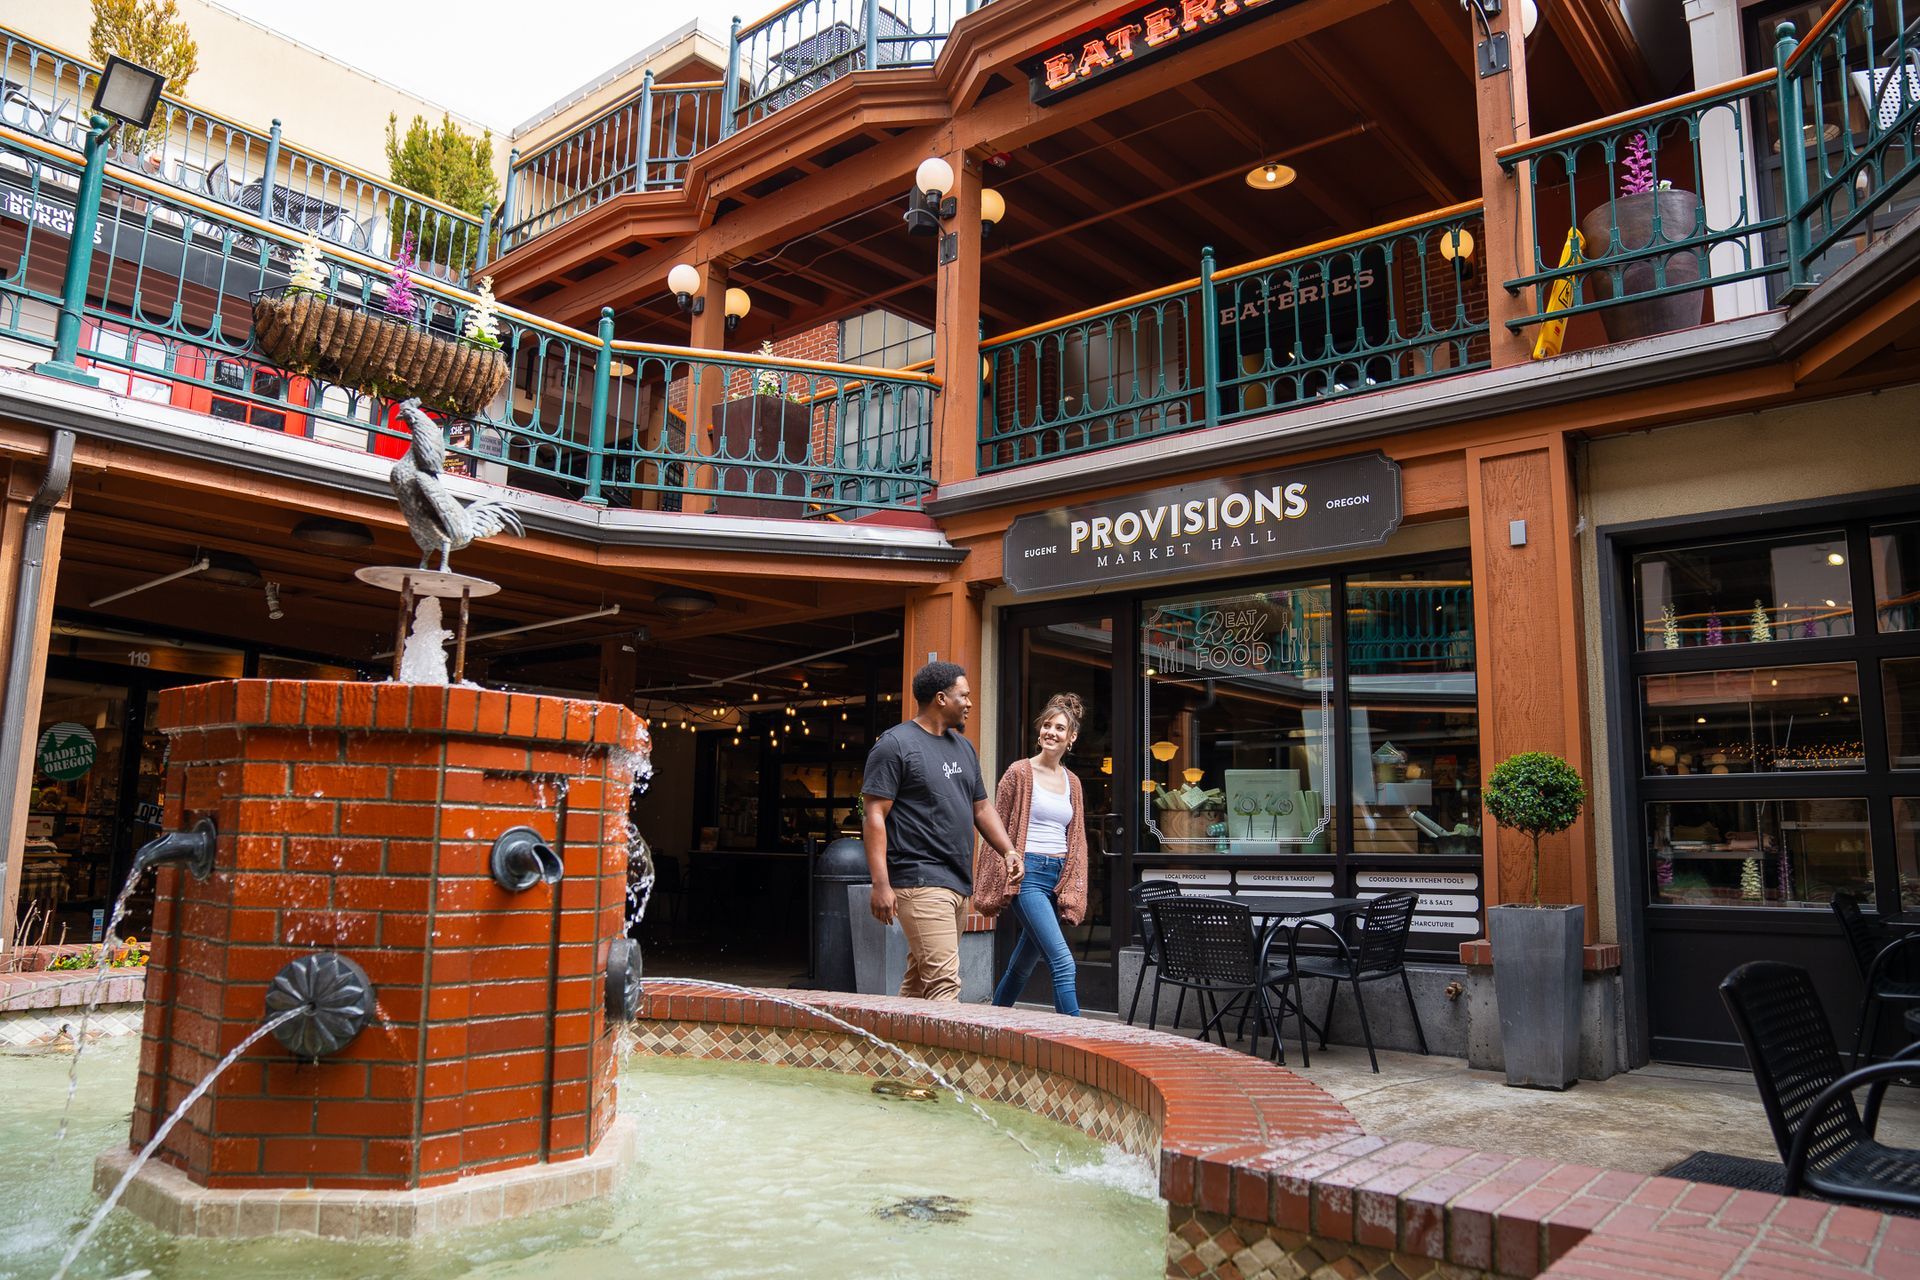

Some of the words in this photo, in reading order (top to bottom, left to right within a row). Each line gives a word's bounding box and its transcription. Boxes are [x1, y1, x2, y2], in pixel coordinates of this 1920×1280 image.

[9, 191, 104, 232] NORTHWT
[1220, 269, 1375, 326] EATERIES
[1326, 494, 1370, 510] OREGON
[1070, 482, 1309, 554] PROVISIONS
[1024, 545, 1058, 558] EUGENE
[1097, 542, 1192, 568] MARKET
[1211, 530, 1276, 550] HALL
[1225, 609, 1257, 628] EAT
[1193, 610, 1268, 648] Real
[127, 650, 151, 667] 119
[1195, 642, 1272, 671] FOOD
[43, 747, 77, 763] MADE
[79, 743, 94, 754] IN
[44, 754, 94, 774] OREGON
[139, 804, 164, 824] OPE
